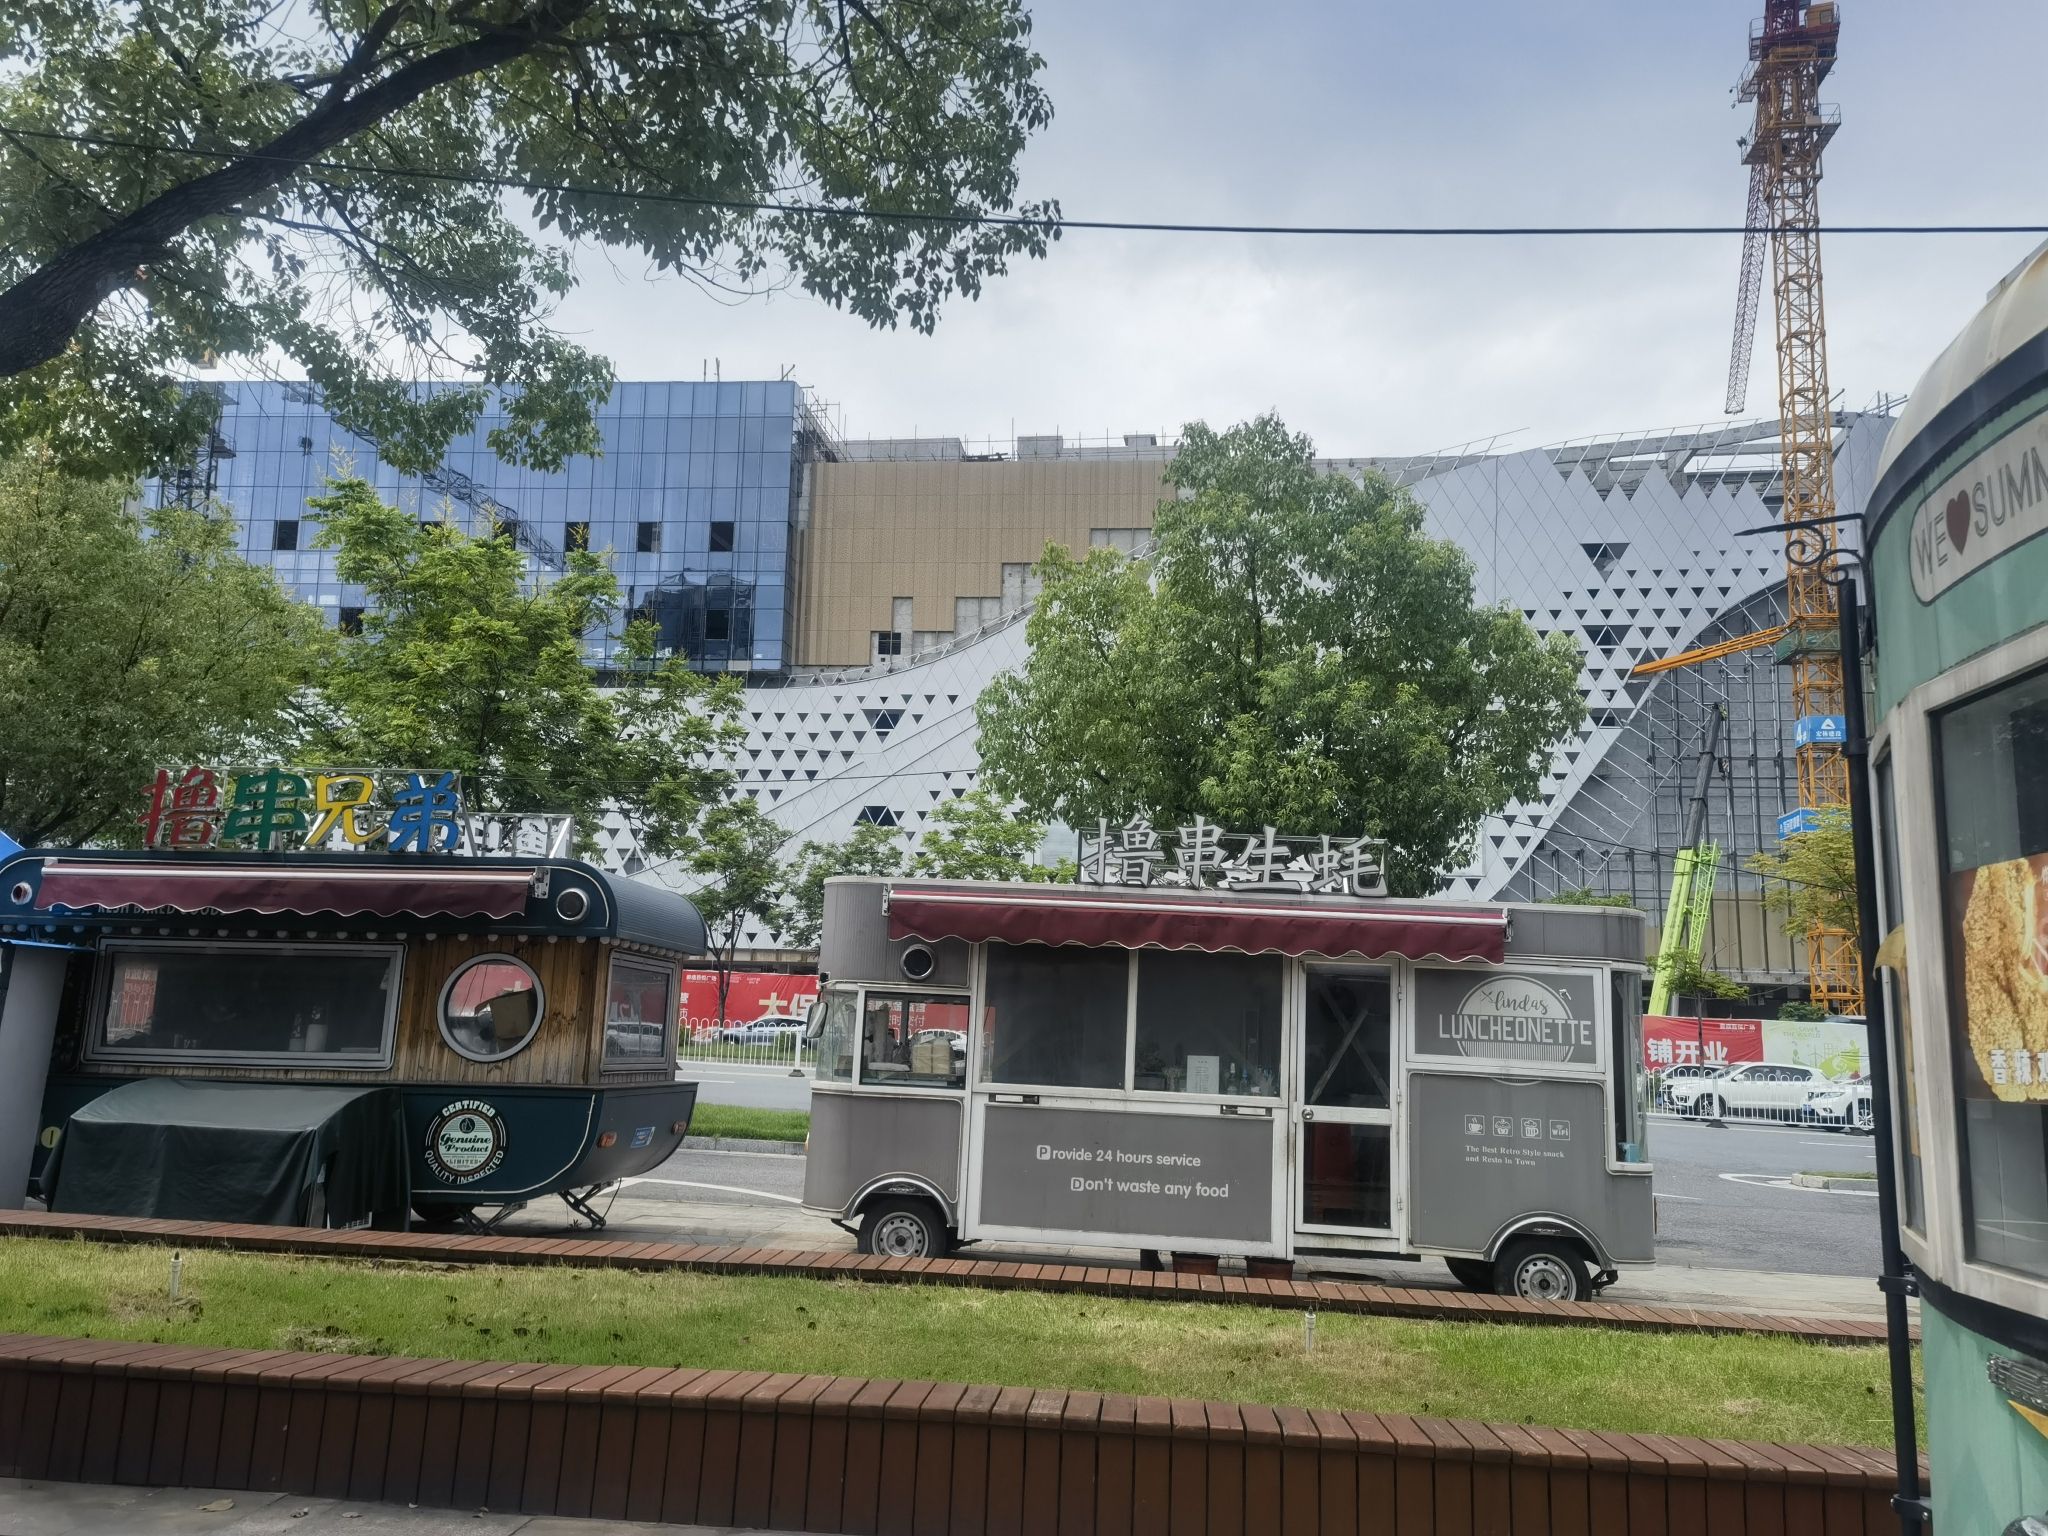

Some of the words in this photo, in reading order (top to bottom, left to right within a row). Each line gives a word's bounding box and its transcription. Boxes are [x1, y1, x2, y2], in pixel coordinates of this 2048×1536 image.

[1915, 511, 1949, 579] WE
[137, 765, 461, 854] 撸串兄弟
[1080, 813, 1388, 897] 撸串生蚝
[1439, 1014, 1592, 1045] LUNCHEONETTE
[1647, 1038, 1729, 1065] 铺开业
[441, 1100, 496, 1117] CERTIFIED
[440, 1133, 491, 1146] Genuine
[445, 1144, 489, 1153] Product
[1465, 1145, 1479, 1153] The
[1482, 1145, 1498, 1154] Best
[425, 1150, 456, 1183] QUALITY
[1036, 1145, 1093, 1161] Provide
[1096, 1149, 1113, 1162] 24
[1116, 1150, 1153, 1164] hours
[1156, 1153, 1201, 1167] service
[1514, 1157, 1536, 1166] Town
[1071, 1177, 1113, 1192] Don't
[1117, 1180, 1160, 1194] waste
[1164, 1184, 1192, 1199] any
[1196, 1182, 1229, 1198] food
